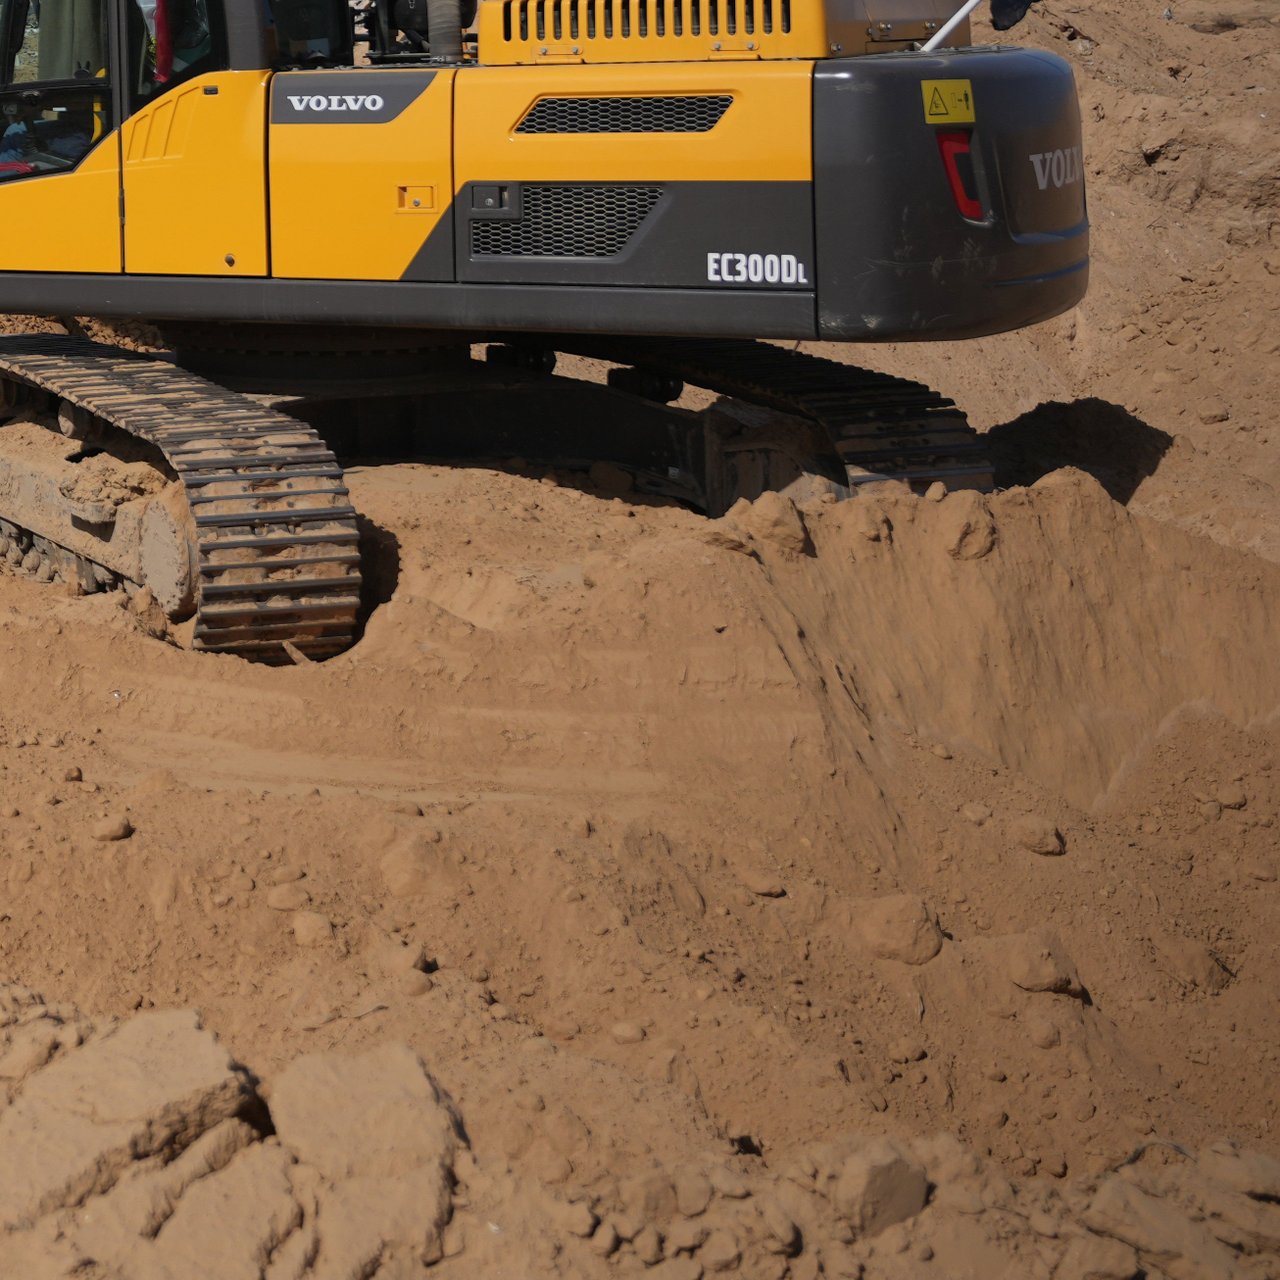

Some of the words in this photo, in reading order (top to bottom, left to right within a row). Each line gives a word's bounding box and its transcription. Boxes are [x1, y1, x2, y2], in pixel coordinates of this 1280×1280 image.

[286, 94, 385, 111] VOLVO
[1029, 145, 1082, 190] VOLV
[707, 252, 808, 283] EC300DL
